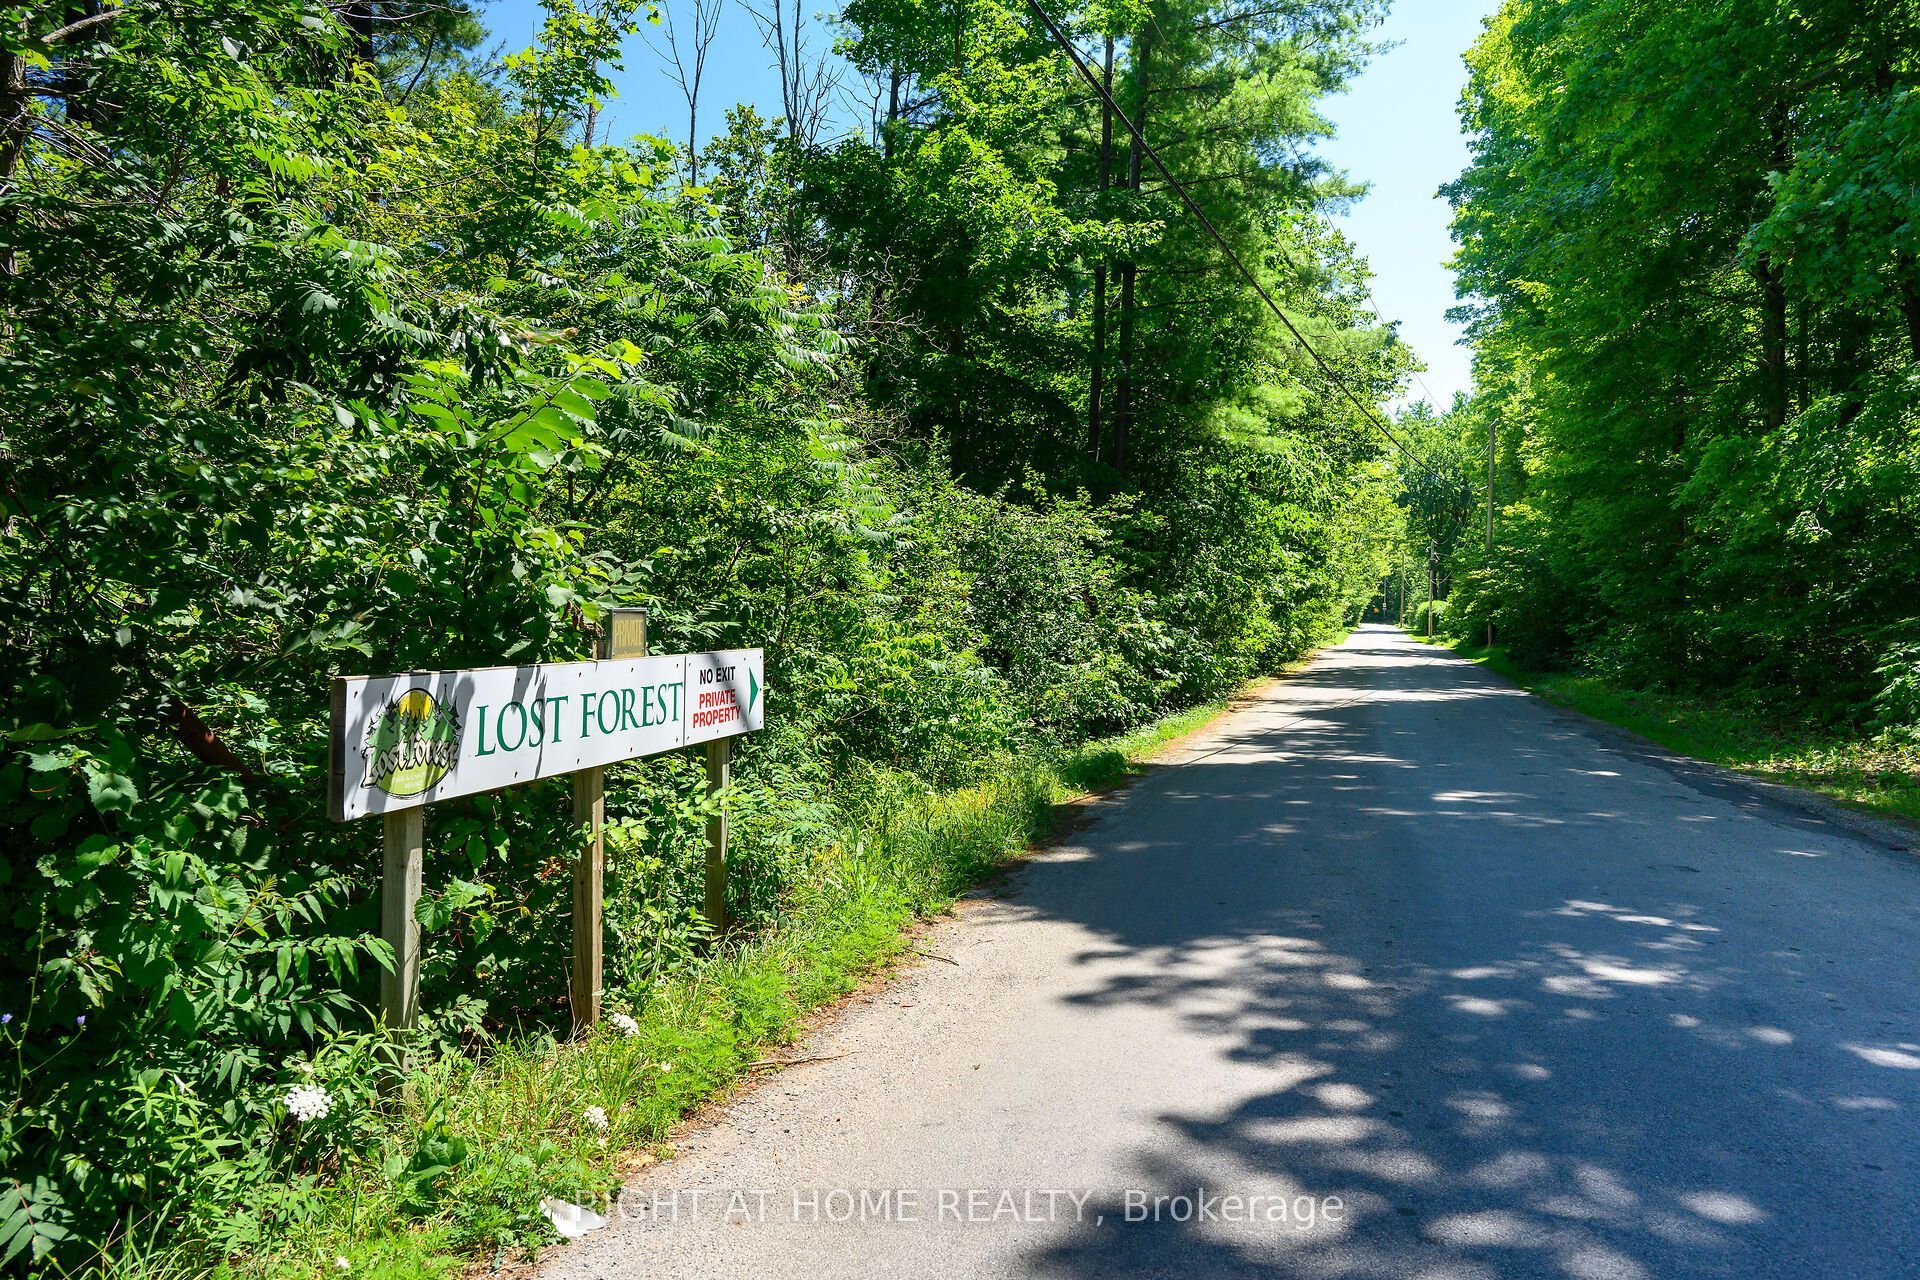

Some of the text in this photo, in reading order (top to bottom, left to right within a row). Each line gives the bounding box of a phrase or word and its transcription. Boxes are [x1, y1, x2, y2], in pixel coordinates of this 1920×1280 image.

[614, 619, 643, 648] PRIVATE
[700, 666, 736, 685] NO EXIT
[699, 688, 736, 709] PRIVATE
[475, 682, 683, 757] LOST FOREST
[693, 705, 741, 728] PROPERTY
[361, 735, 407, 788] Lost
